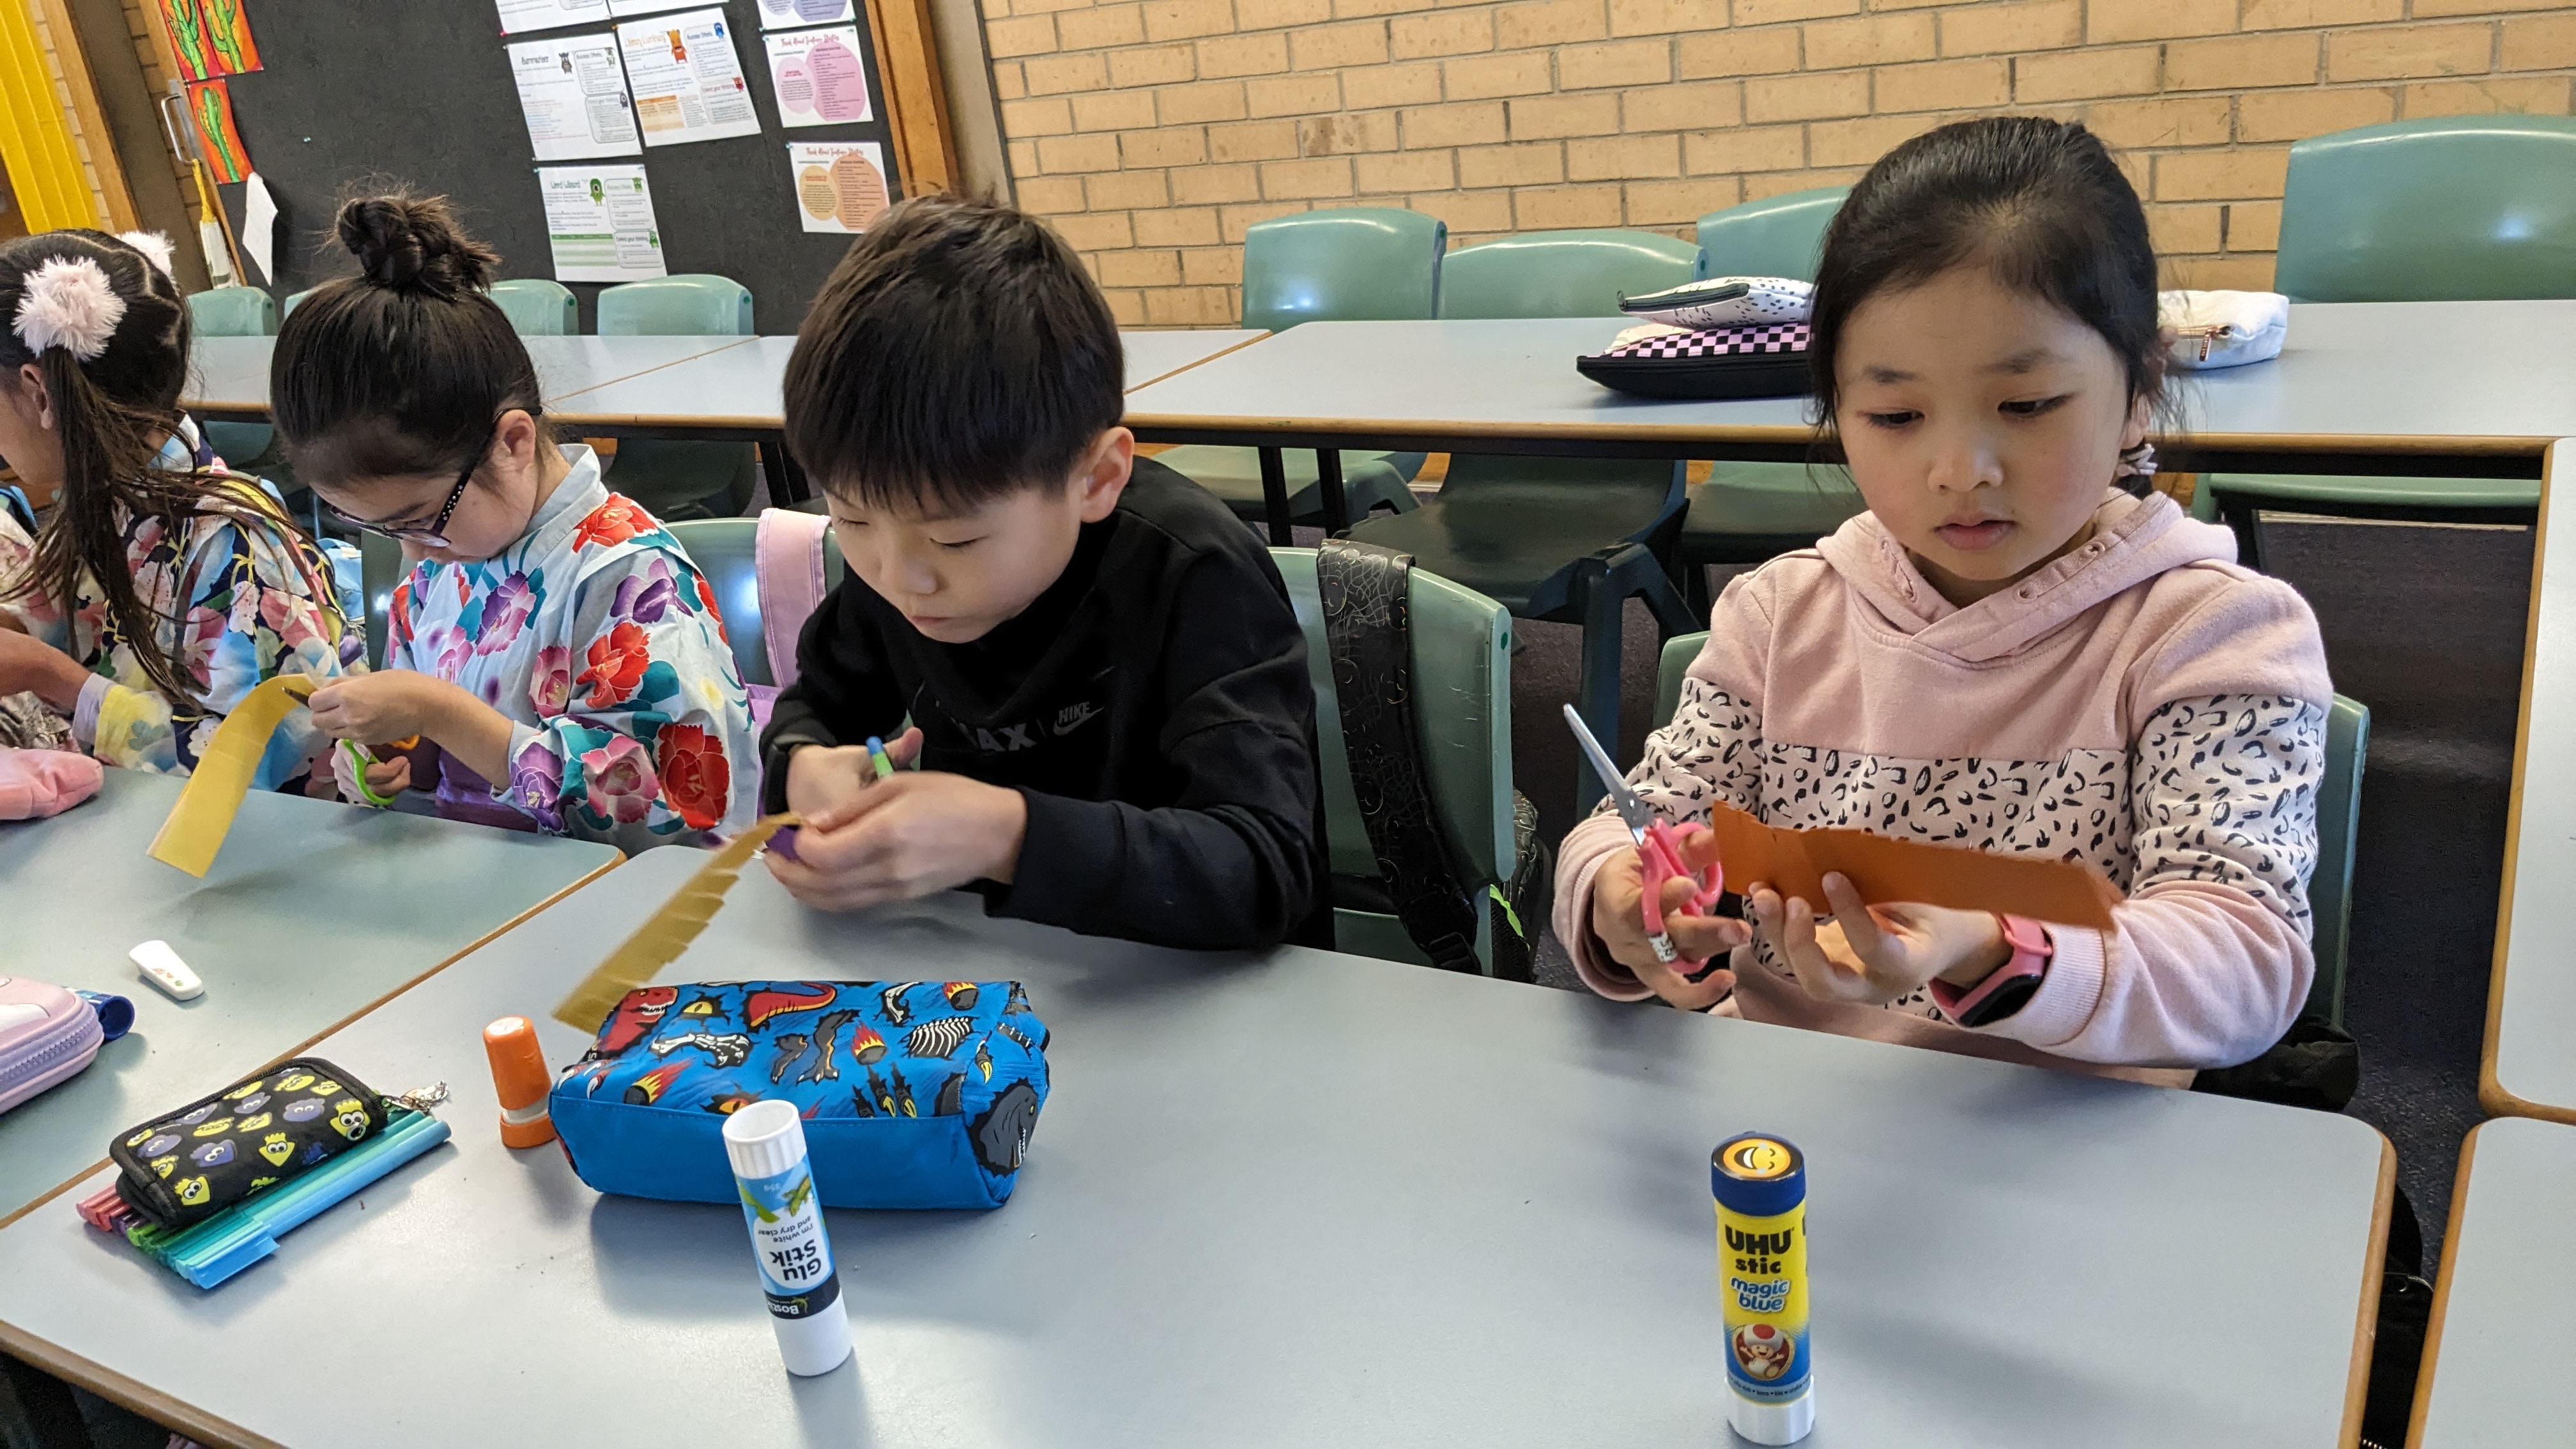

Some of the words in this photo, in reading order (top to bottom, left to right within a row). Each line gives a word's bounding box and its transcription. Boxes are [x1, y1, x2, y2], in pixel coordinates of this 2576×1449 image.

[1059, 702, 1090, 724] NIKE
[781, 1225, 796, 1234] dry
[797, 1215, 811, 1227] and
[758, 1229, 778, 1237] clear
[773, 1231, 800, 1243] white
[1725, 1223, 1791, 1255] UHU
[769, 1238, 816, 1267] Stik
[783, 1257, 822, 1281] Glu
[1735, 1257, 1781, 1275] stic
[1730, 1277, 1789, 1298] magic
[1738, 1292, 1783, 1311] blue
